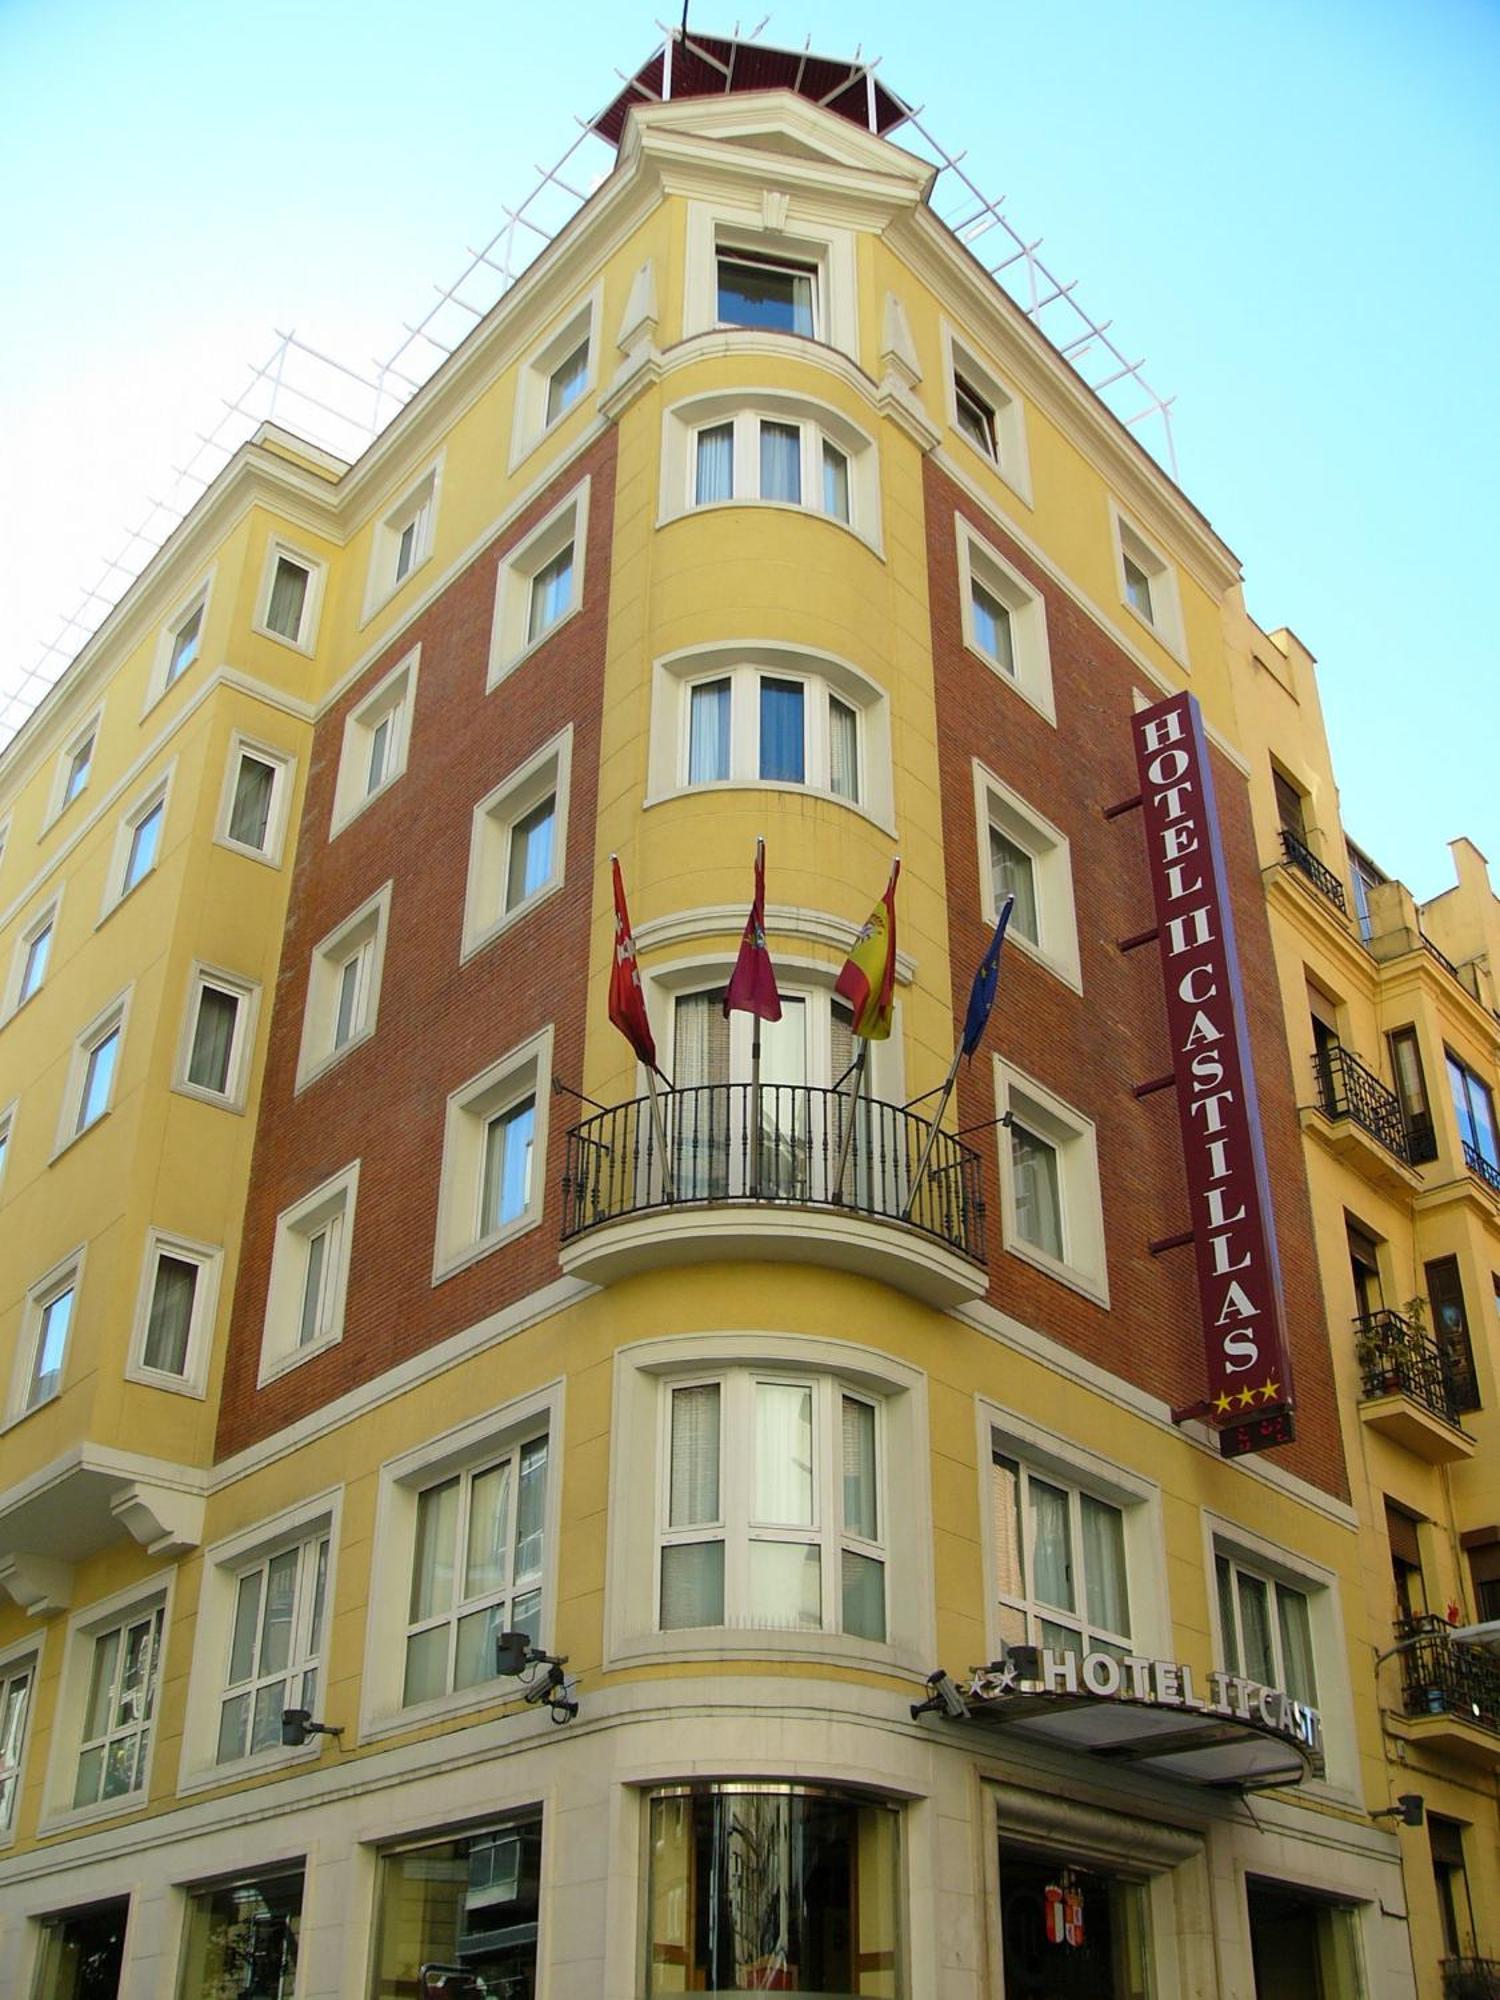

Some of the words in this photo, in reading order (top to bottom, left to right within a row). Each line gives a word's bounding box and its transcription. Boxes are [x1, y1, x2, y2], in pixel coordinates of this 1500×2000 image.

[1141, 709, 1202, 901] HOTEL
[1165, 905, 1216, 957] II
[1178, 963, 1261, 1374] CASTILLAS
[1042, 1648, 1204, 1708] HOTEL
